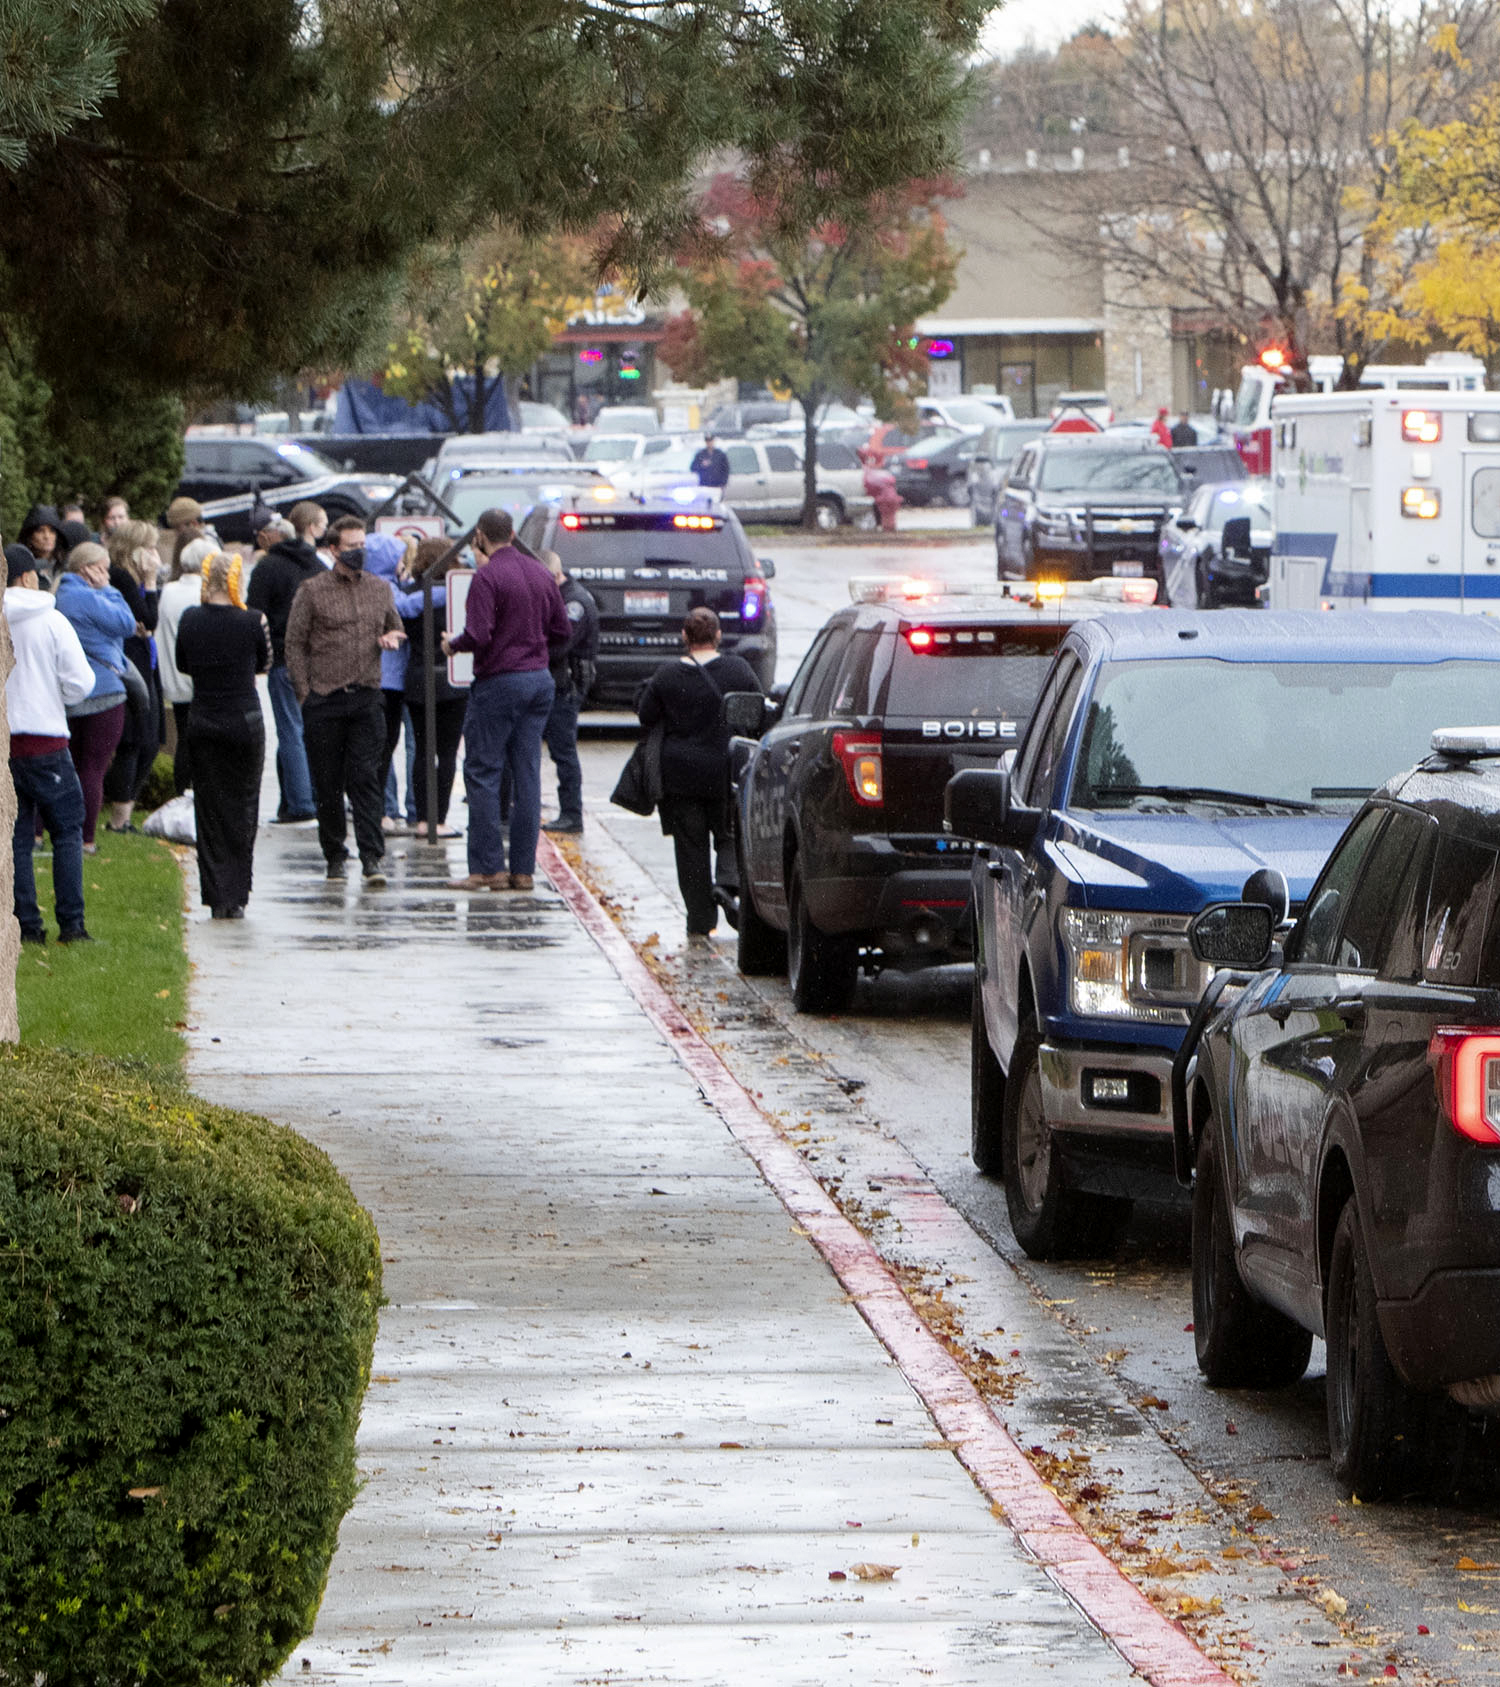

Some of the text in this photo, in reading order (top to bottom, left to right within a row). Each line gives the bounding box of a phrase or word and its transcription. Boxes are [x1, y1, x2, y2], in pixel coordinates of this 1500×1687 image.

[569, 567, 728, 581] BOISE POLICE
[922, 721, 1016, 737] BOISE
